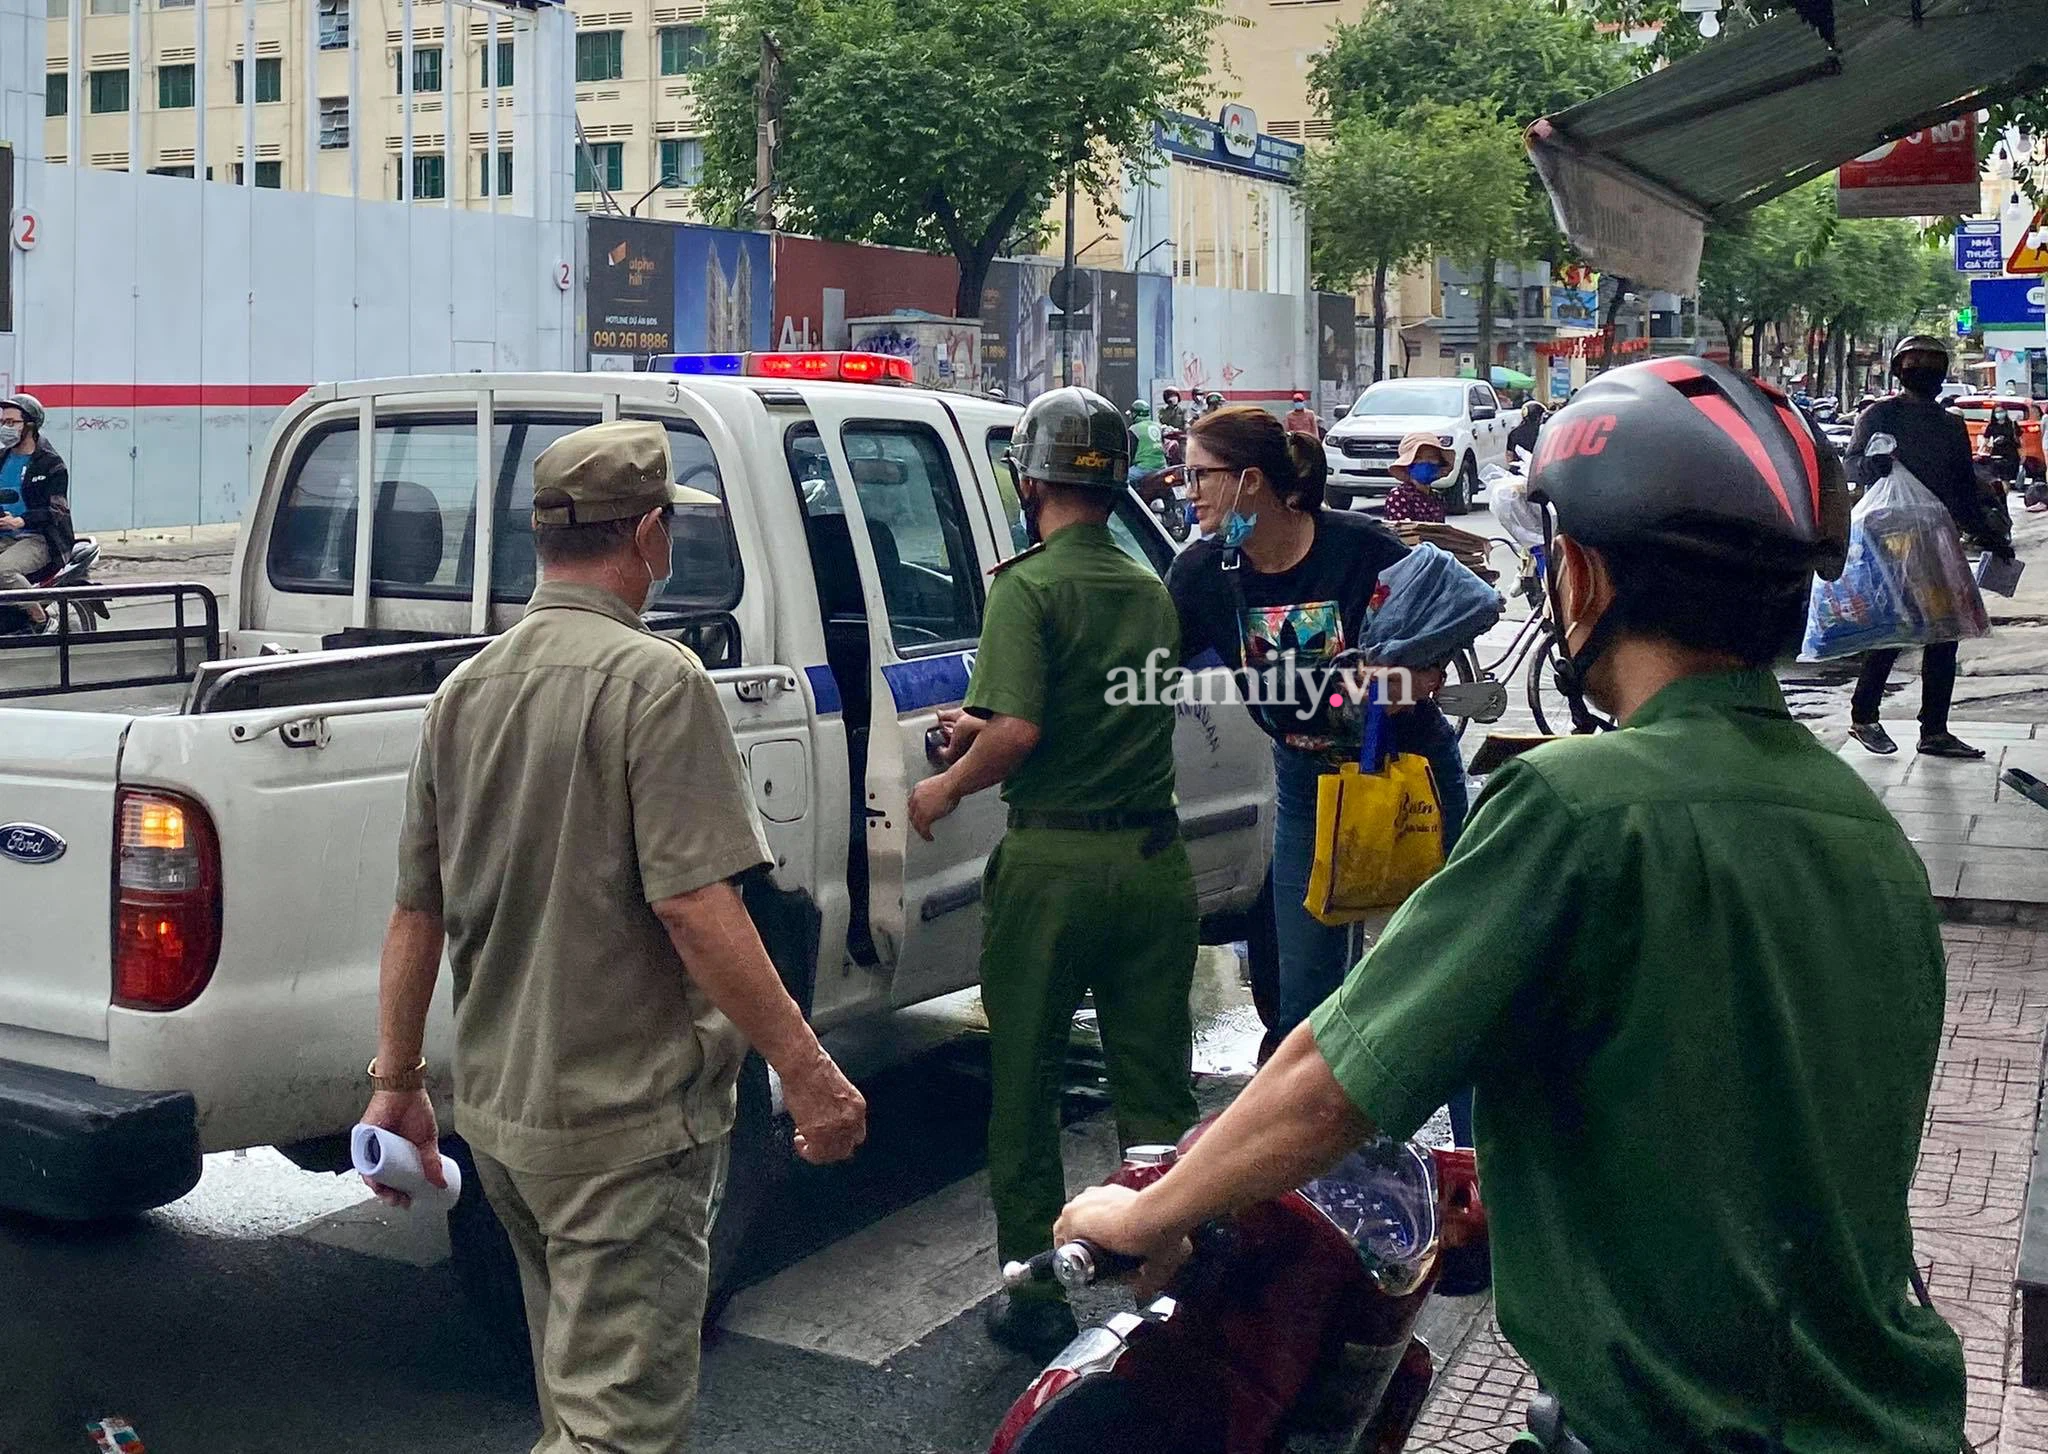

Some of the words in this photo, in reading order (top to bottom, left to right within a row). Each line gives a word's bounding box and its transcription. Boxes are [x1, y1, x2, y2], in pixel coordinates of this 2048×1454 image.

[21, 215, 35, 242] 2
[561, 264, 569, 284] 2
[594, 331, 616, 347] 090
[619, 332, 637, 348] 261
[640, 333, 668, 348] 8886
[7, 830, 45, 853] Ford
